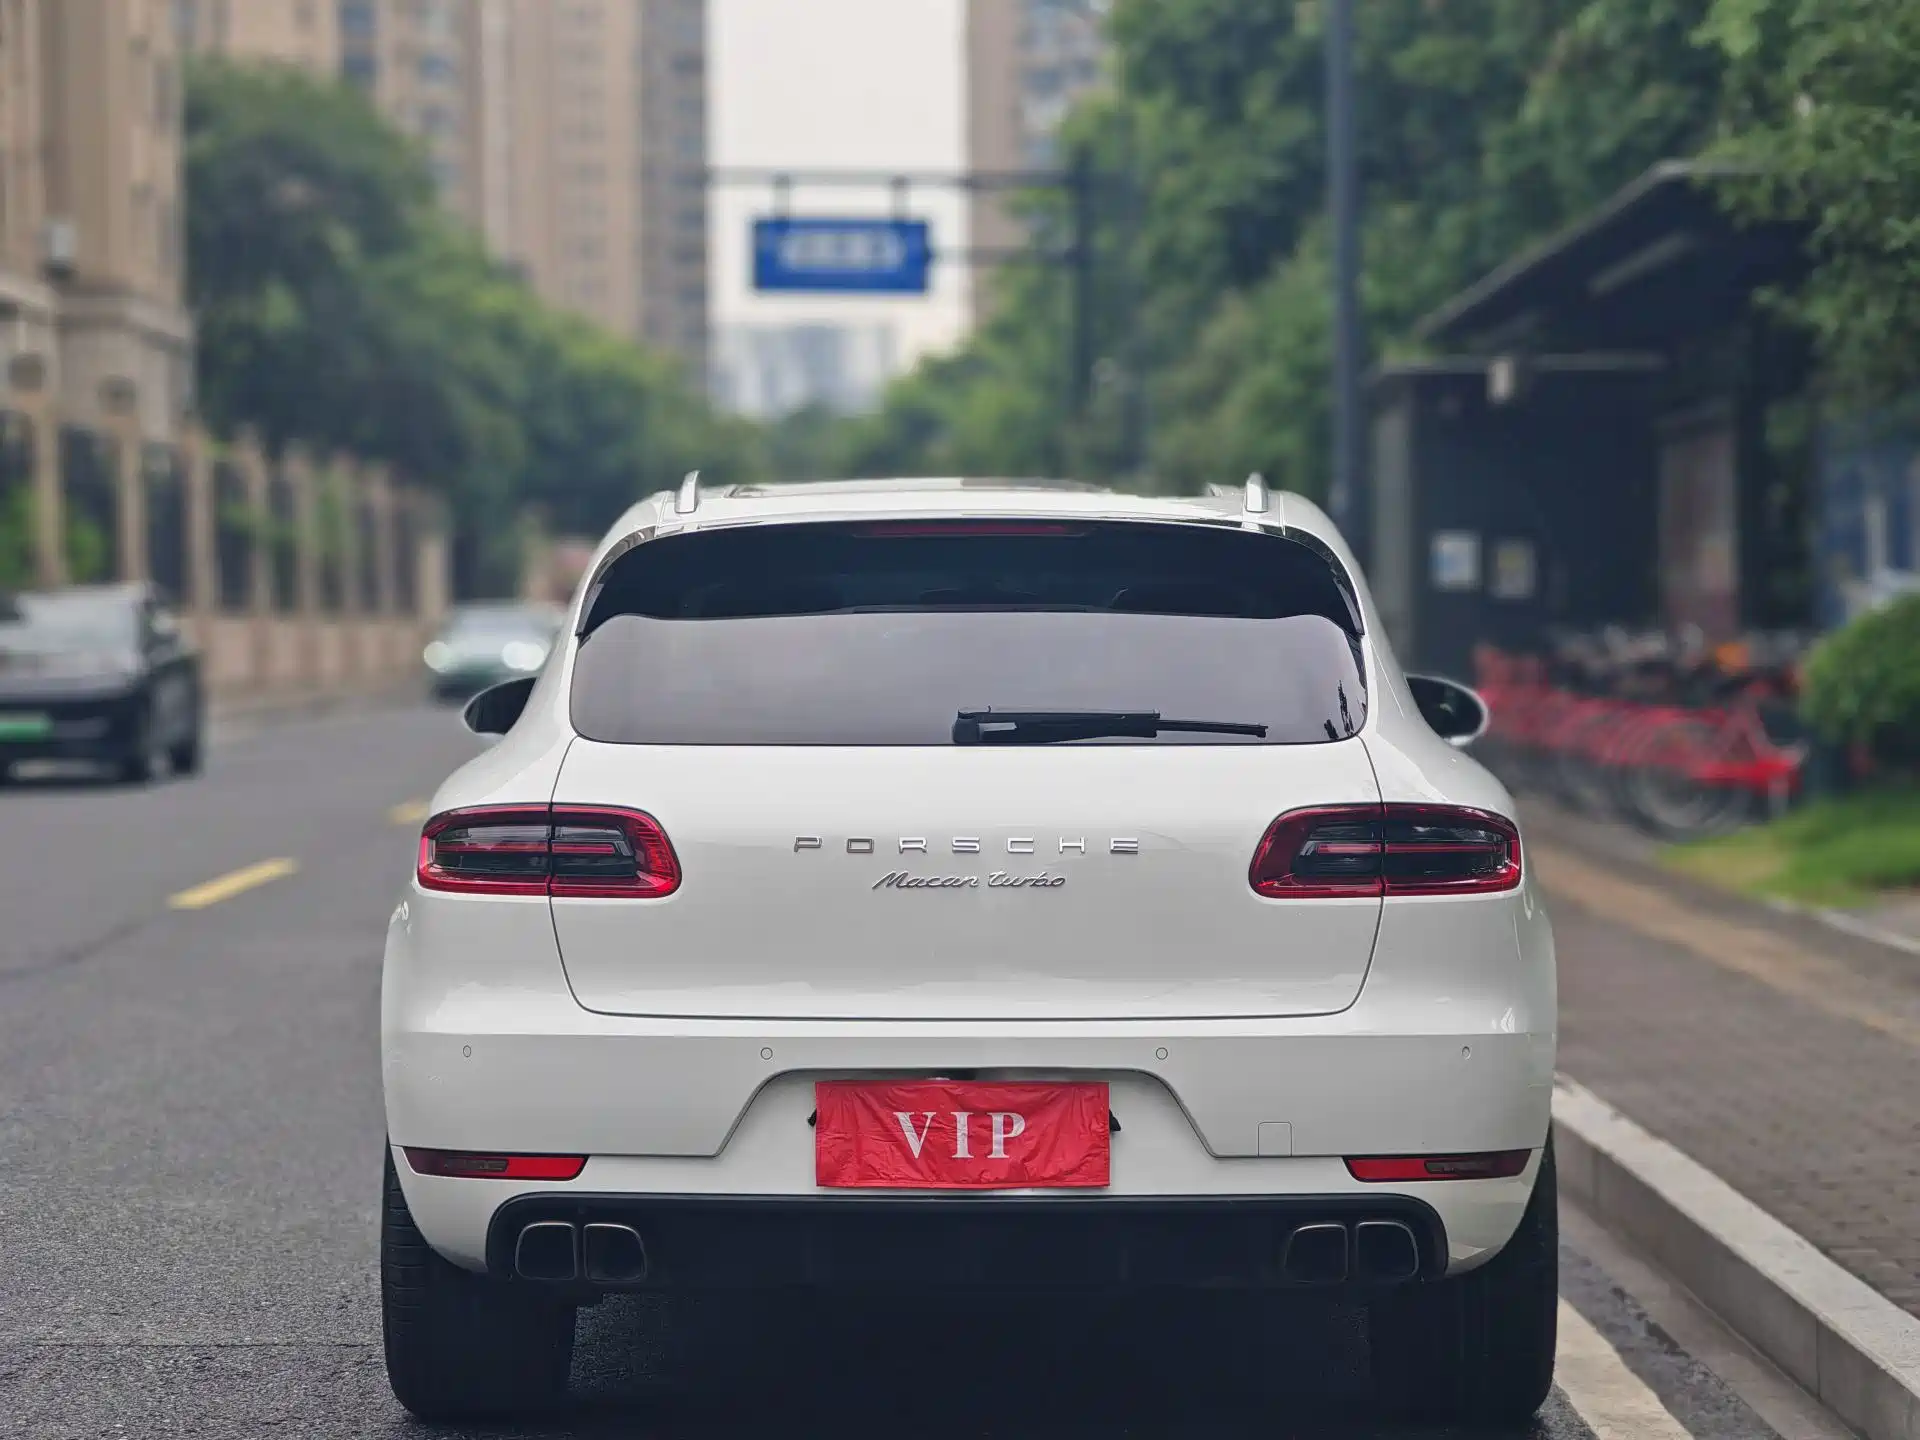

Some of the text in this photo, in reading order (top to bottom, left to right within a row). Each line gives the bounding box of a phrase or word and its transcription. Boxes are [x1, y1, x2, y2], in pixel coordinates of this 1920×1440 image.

[794, 835, 1139, 855] PORSCHE
[872, 869, 980, 890] Macan
[893, 1111, 1026, 1159] VIP
